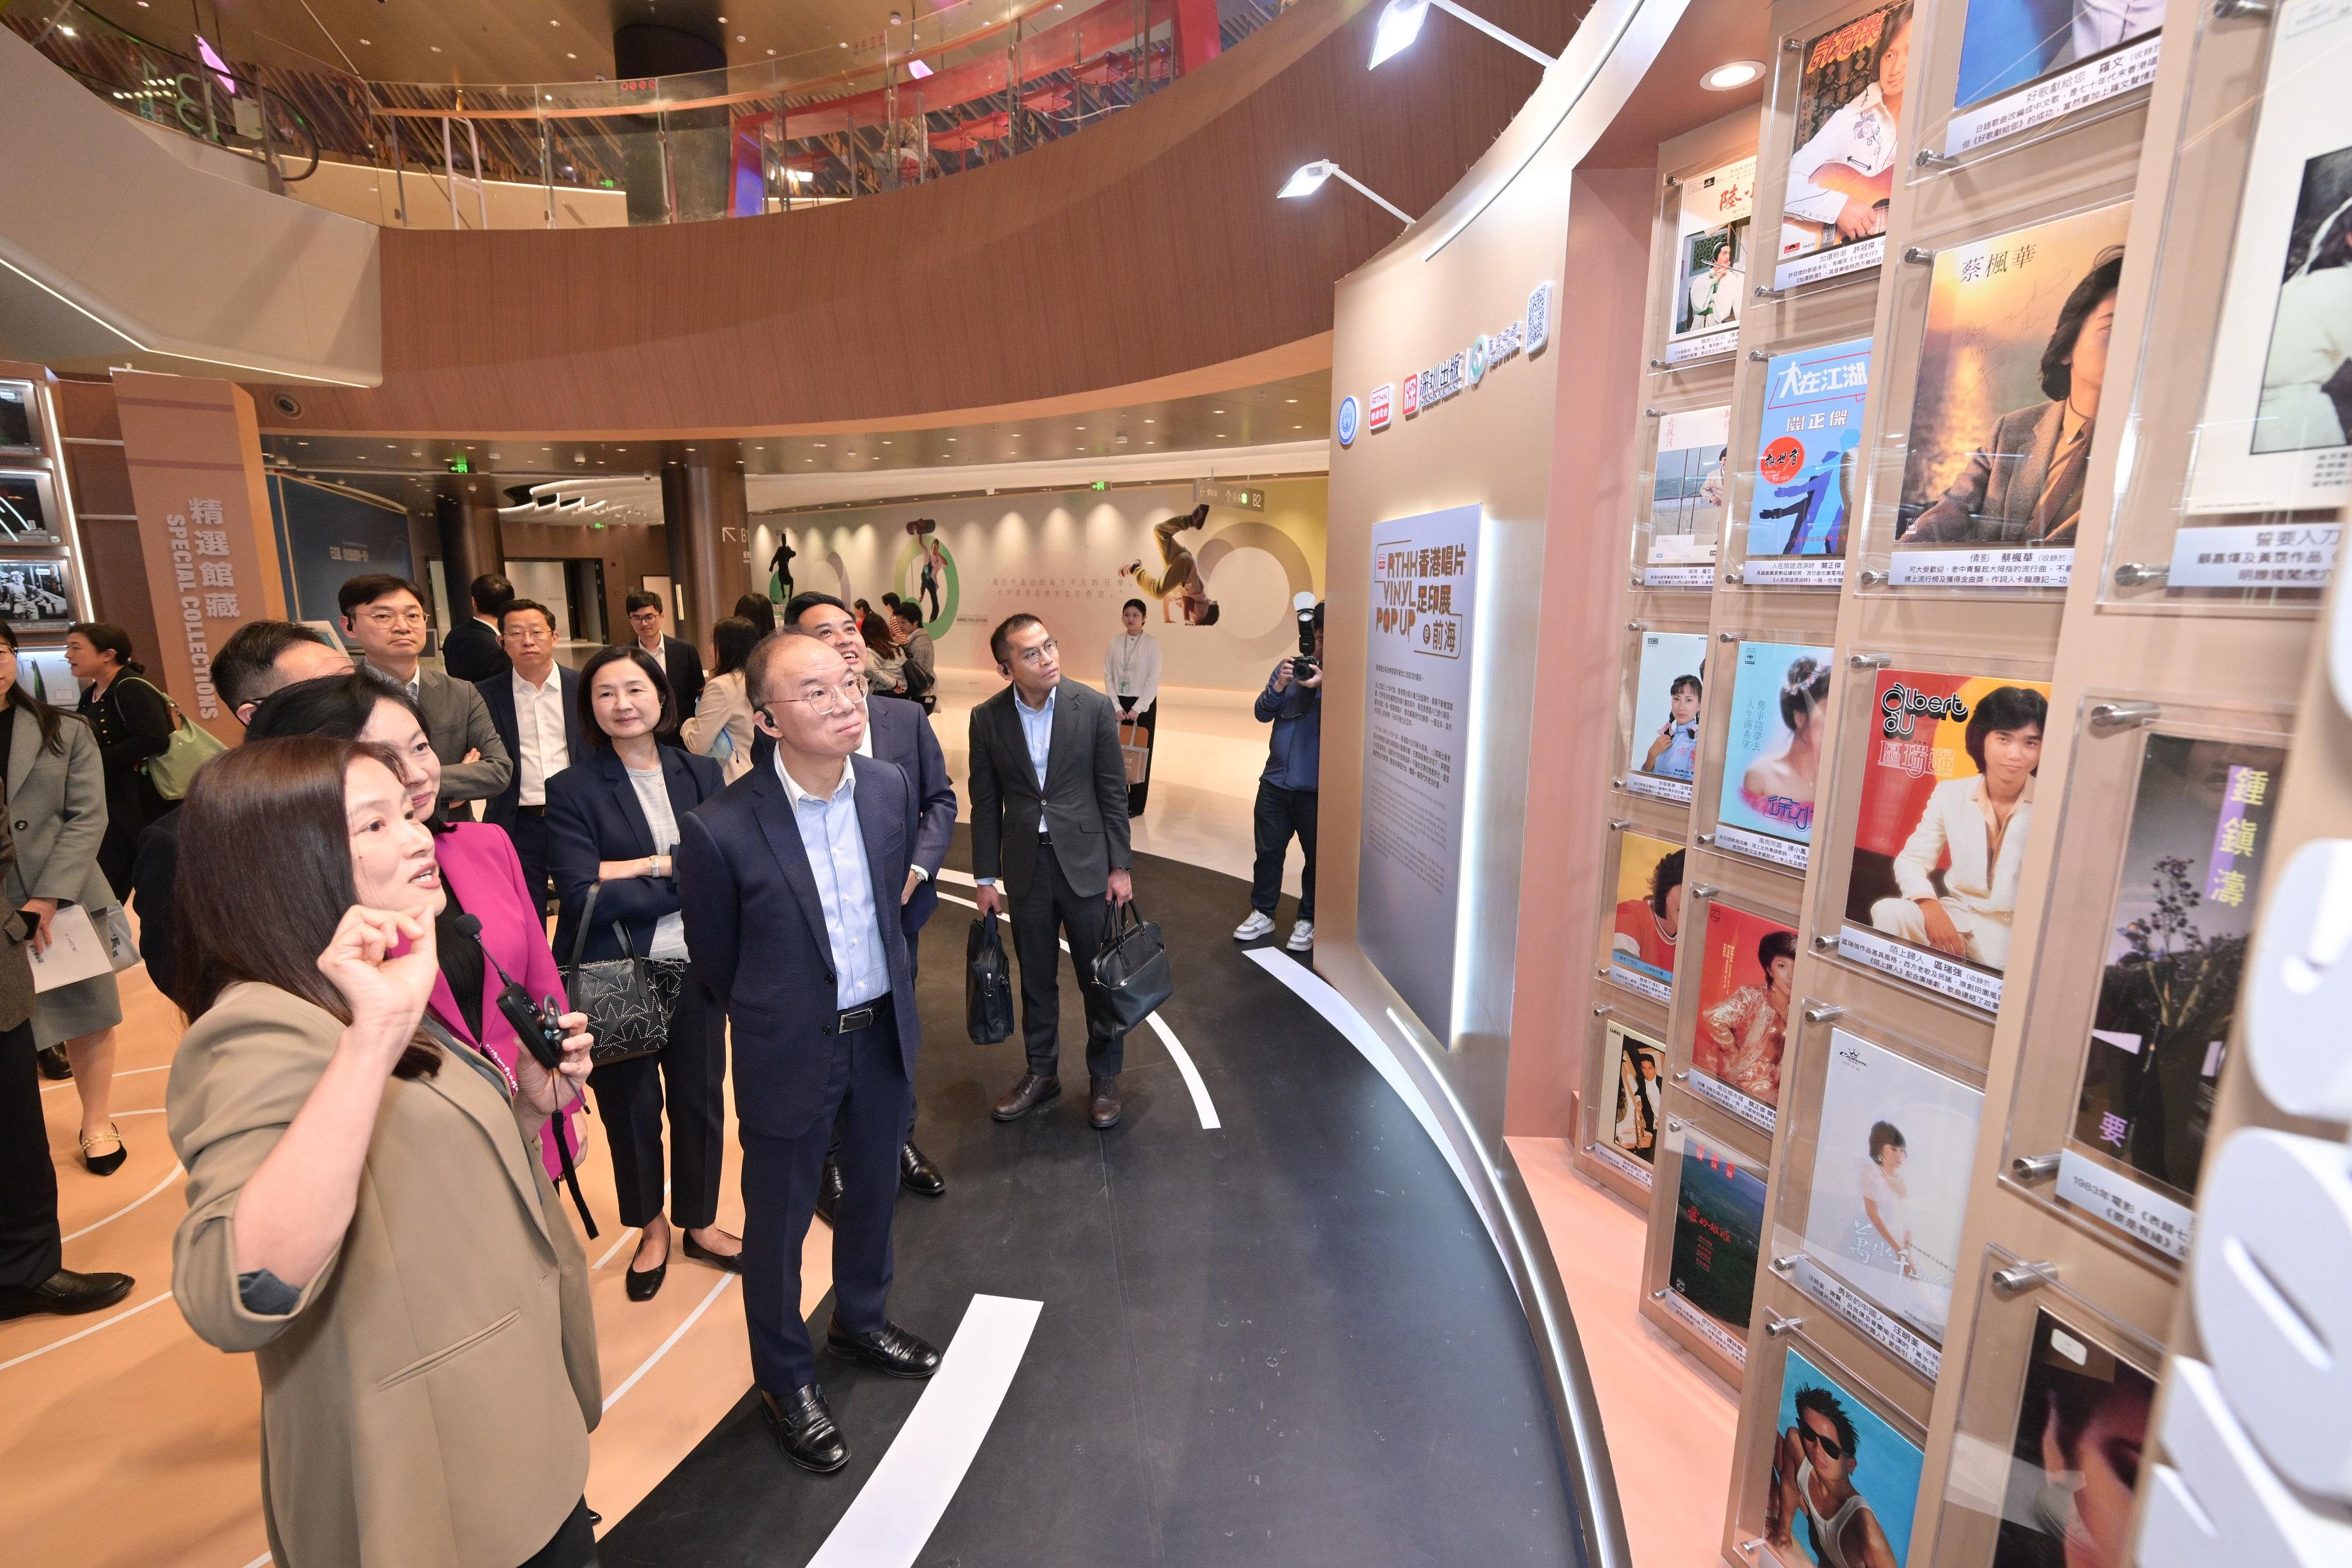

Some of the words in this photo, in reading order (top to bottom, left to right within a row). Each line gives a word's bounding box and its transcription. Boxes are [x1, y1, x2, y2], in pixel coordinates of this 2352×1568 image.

[2026, 71, 2086, 103] 好歌獻給您
[2098, 56, 2124, 75] 羅文
[1820, 249, 1847, 263] 加價熱潮
[1854, 242, 1875, 254] 許冠傑
[1960, 243, 2037, 283] 蔡楓華
[1420, 353, 1459, 396] 深圳出版
[1372, 391, 1388, 406] RTHK
[1787, 409, 1849, 432] 關正傑
[1253, 493, 1261, 507] B2
[188, 498, 240, 619] 精選館藏
[1970, 553, 1990, 563] 倩影
[2001, 553, 2034, 562] 蔡楓華
[165, 514, 192, 593] SPECIAL
[181, 599, 219, 720] COLLECTIONS
[1758, 837, 1782, 849] 風雨同路
[1788, 845, 1806, 855] 徐小鳳
[1889, 944, 1924, 965] 陌上歸人
[1934, 960, 1962, 978] 區瑞強
[1749, 1100, 1765, 1113] 關正傑
[2099, 1112, 2128, 1148] 要
[1838, 1286, 1885, 1325] 勇敢的中國人
[1893, 1325, 1919, 1347] 汪明荃
